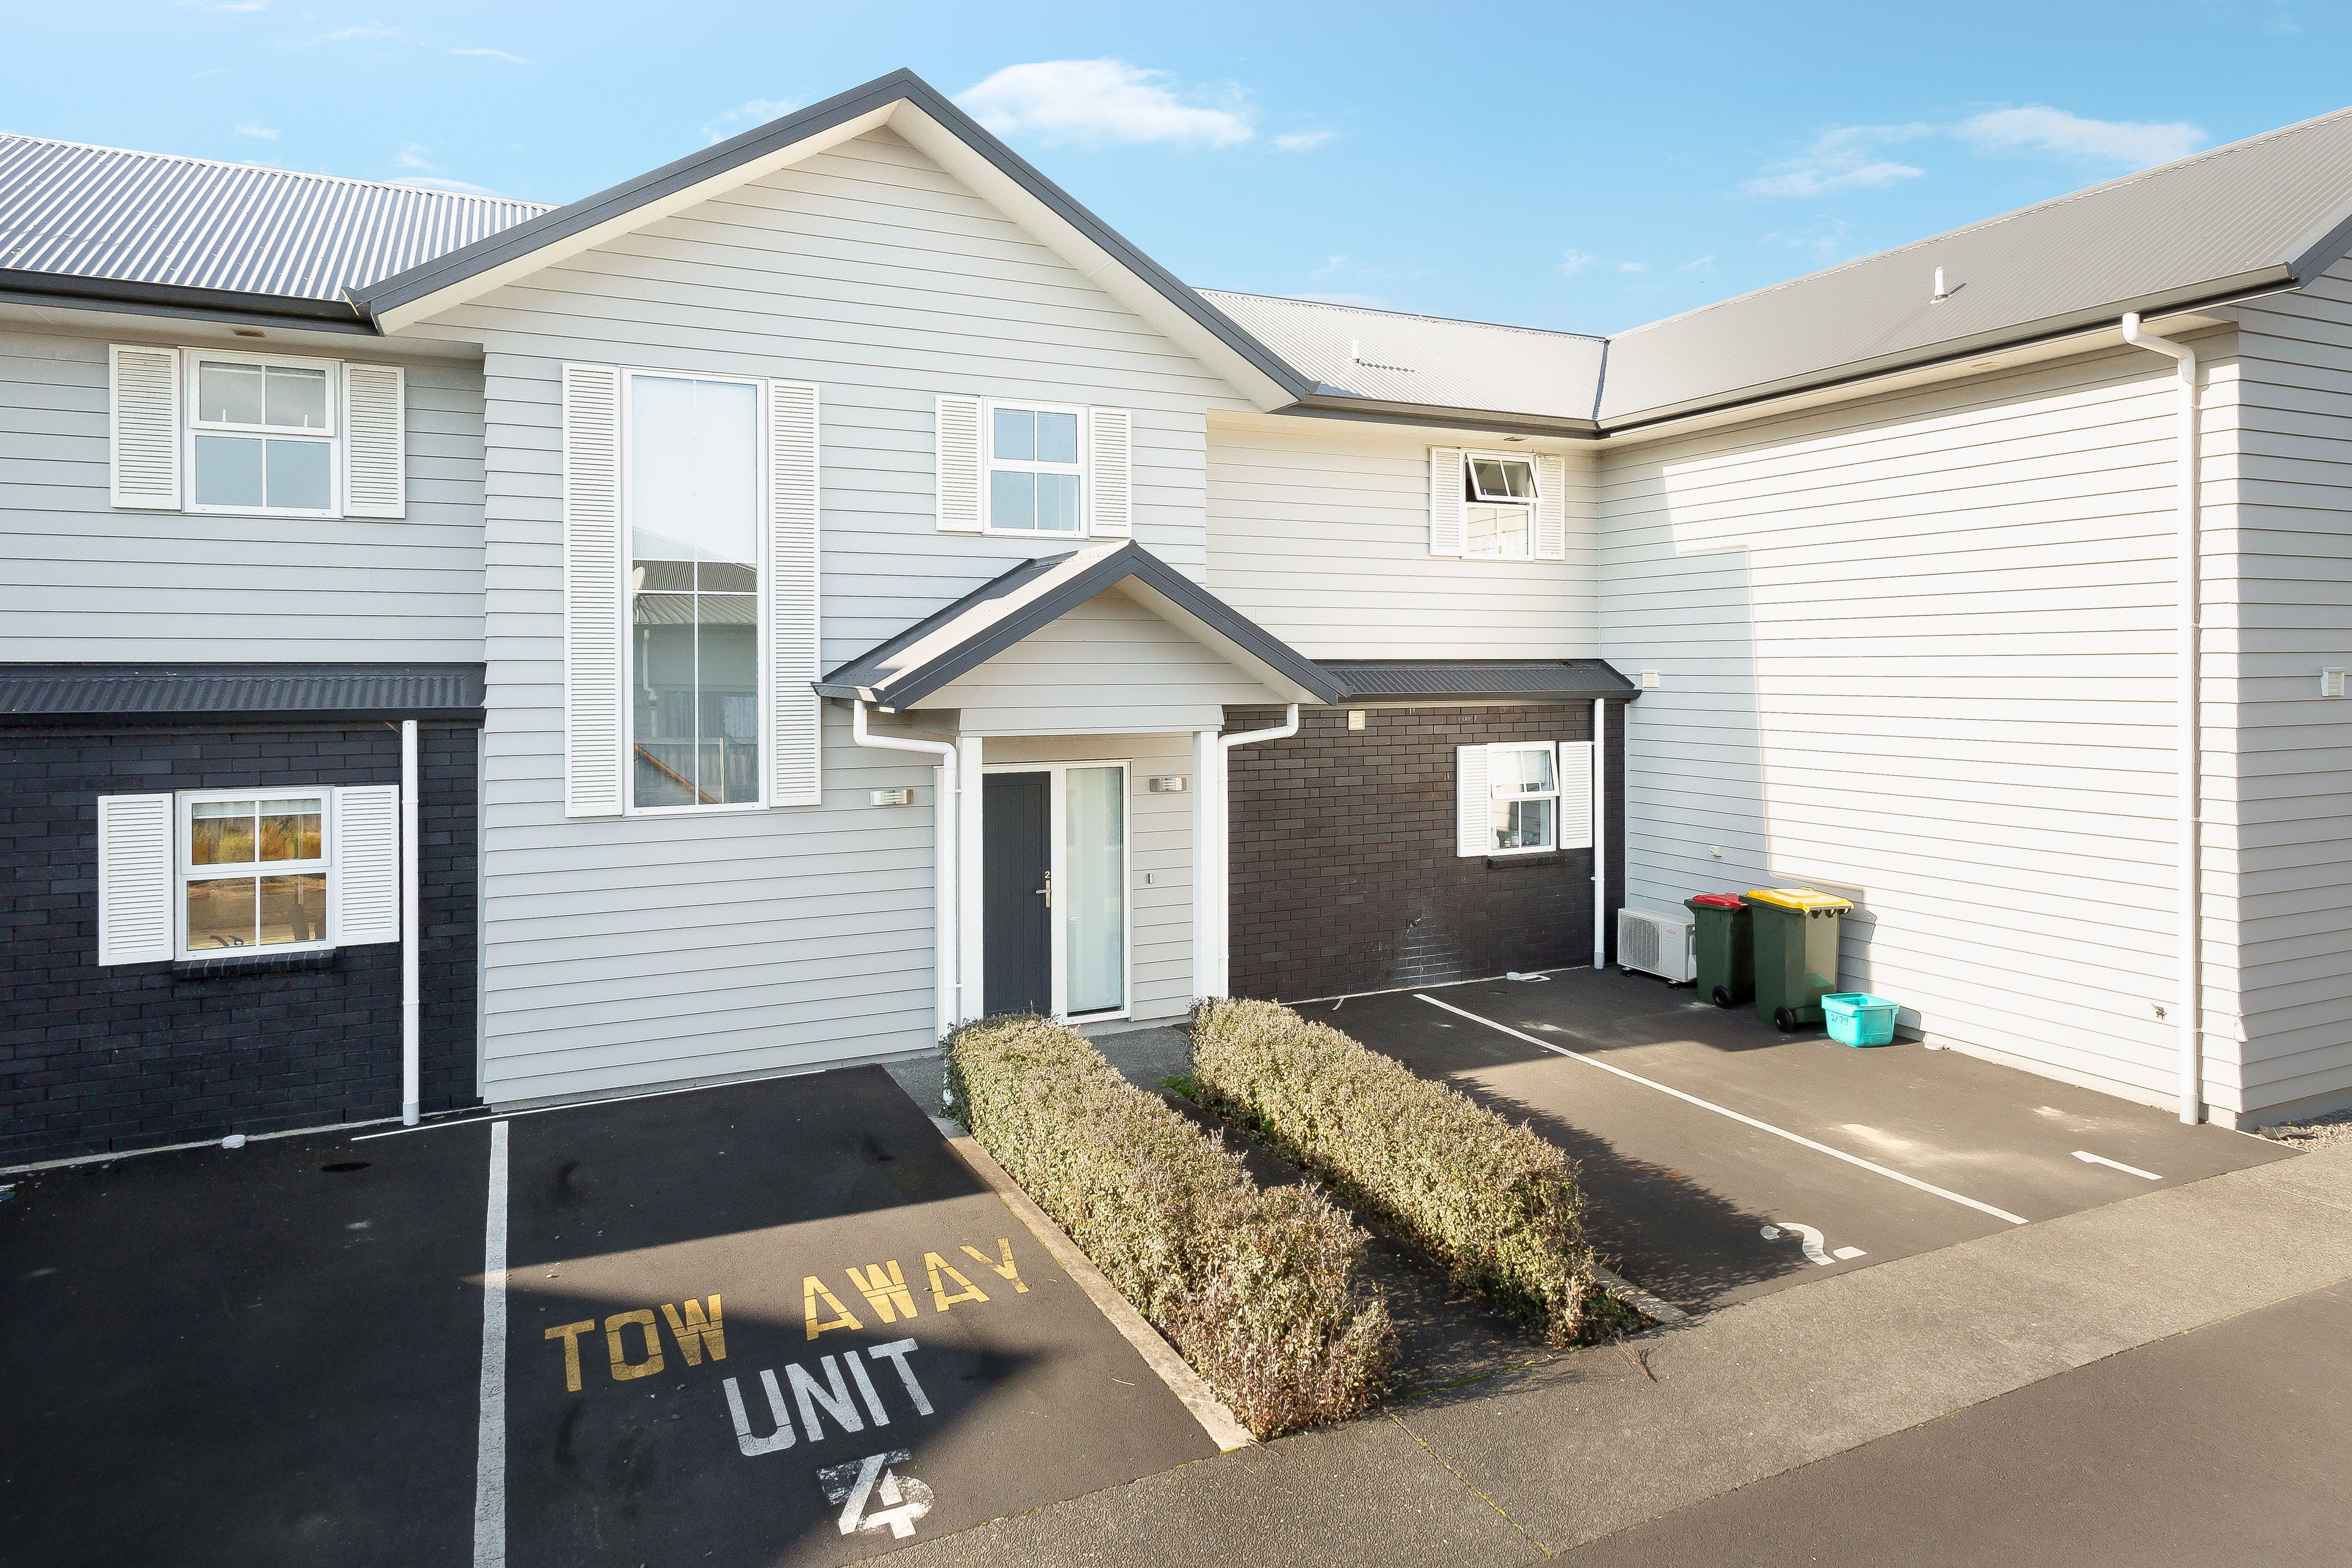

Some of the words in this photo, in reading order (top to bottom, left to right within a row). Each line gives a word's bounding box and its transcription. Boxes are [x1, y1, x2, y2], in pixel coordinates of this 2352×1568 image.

[1044, 870, 1050, 879] 2
[1760, 1222, 1868, 1266] 2
[545, 1294, 728, 1392] TOW
[804, 1238, 1030, 1341] AWAY
[723, 1338, 935, 1457] UNIT
[838, 1452, 920, 1540] 4
